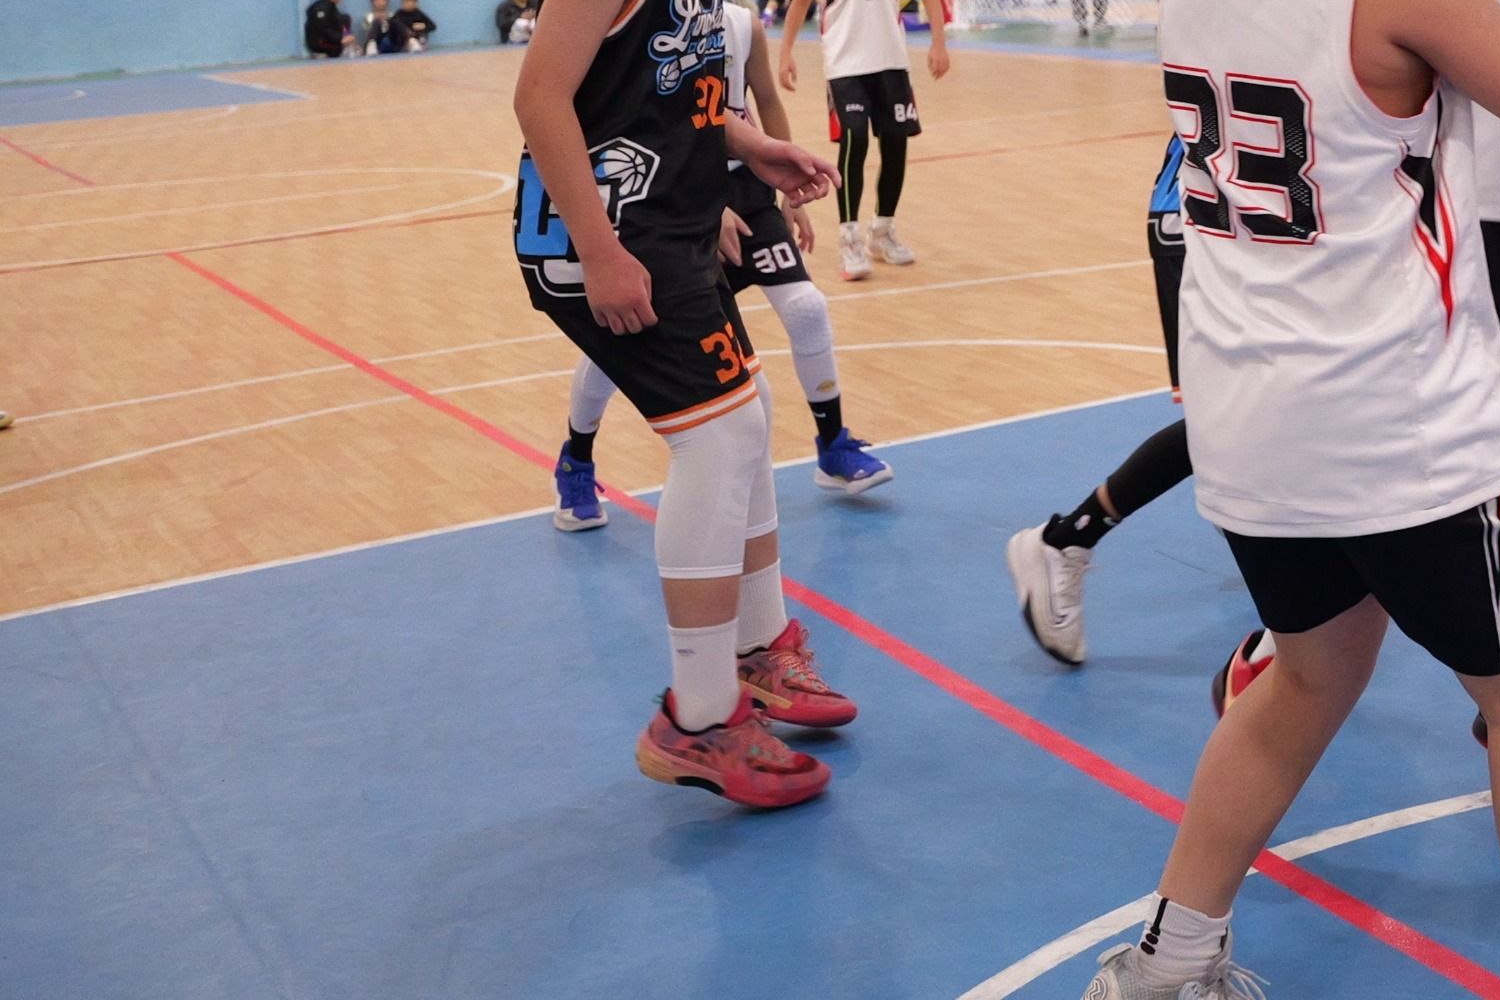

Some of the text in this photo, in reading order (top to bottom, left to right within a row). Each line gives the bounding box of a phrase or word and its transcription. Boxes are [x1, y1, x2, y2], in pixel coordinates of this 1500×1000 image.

[691, 75, 726, 129] 32
[894, 102, 917, 123] 84
[1163, 62, 1326, 246] 33
[752, 241, 797, 274] 30
